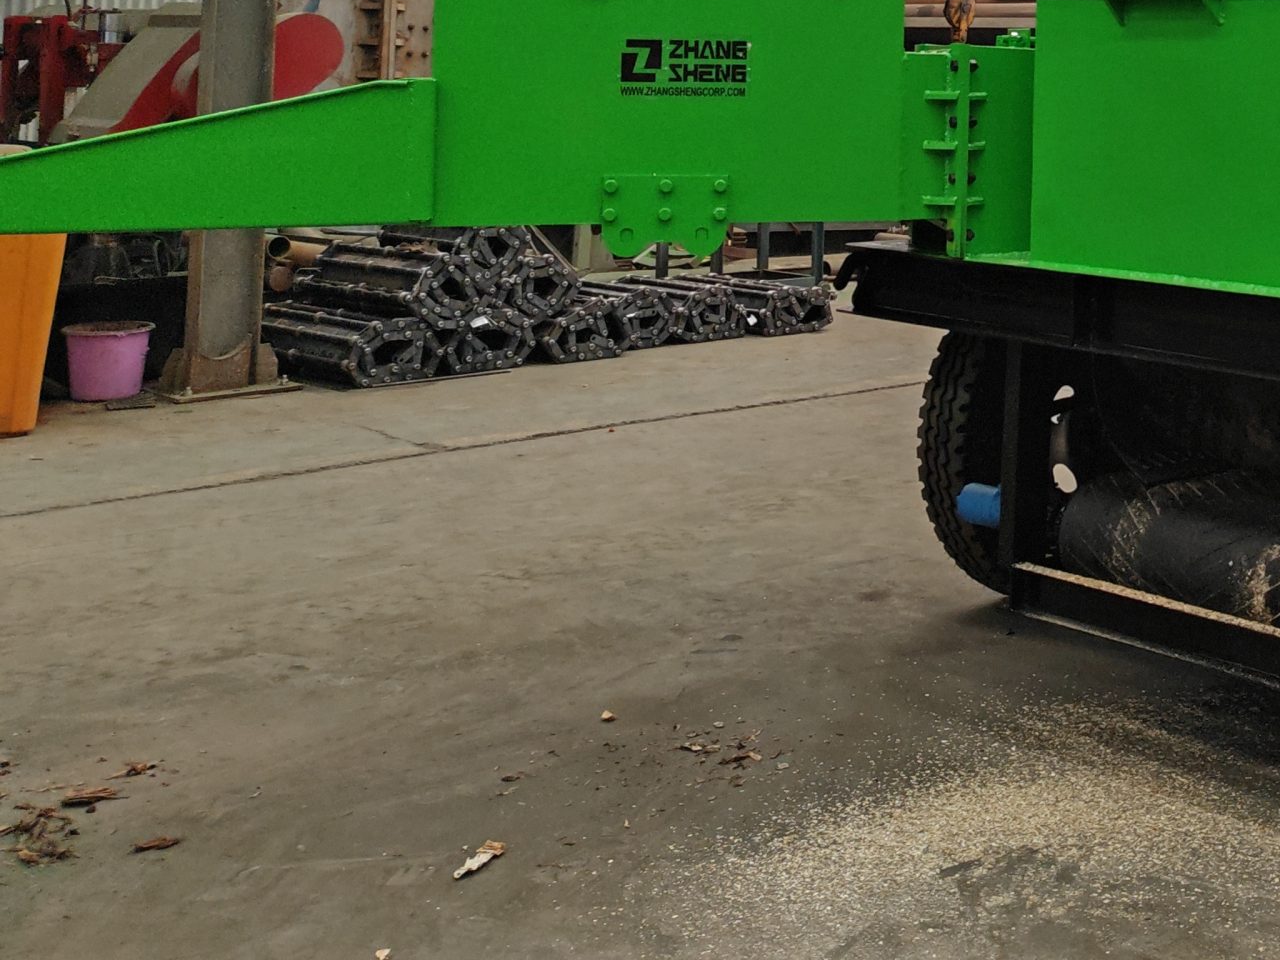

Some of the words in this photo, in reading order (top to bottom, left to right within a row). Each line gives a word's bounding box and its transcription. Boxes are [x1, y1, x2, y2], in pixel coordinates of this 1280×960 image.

[668, 40, 747, 60] ZHANG
[668, 64, 747, 82] SHENG
[620, 86, 746, 97] WWW.ZHANGSHENGCORP.COM
